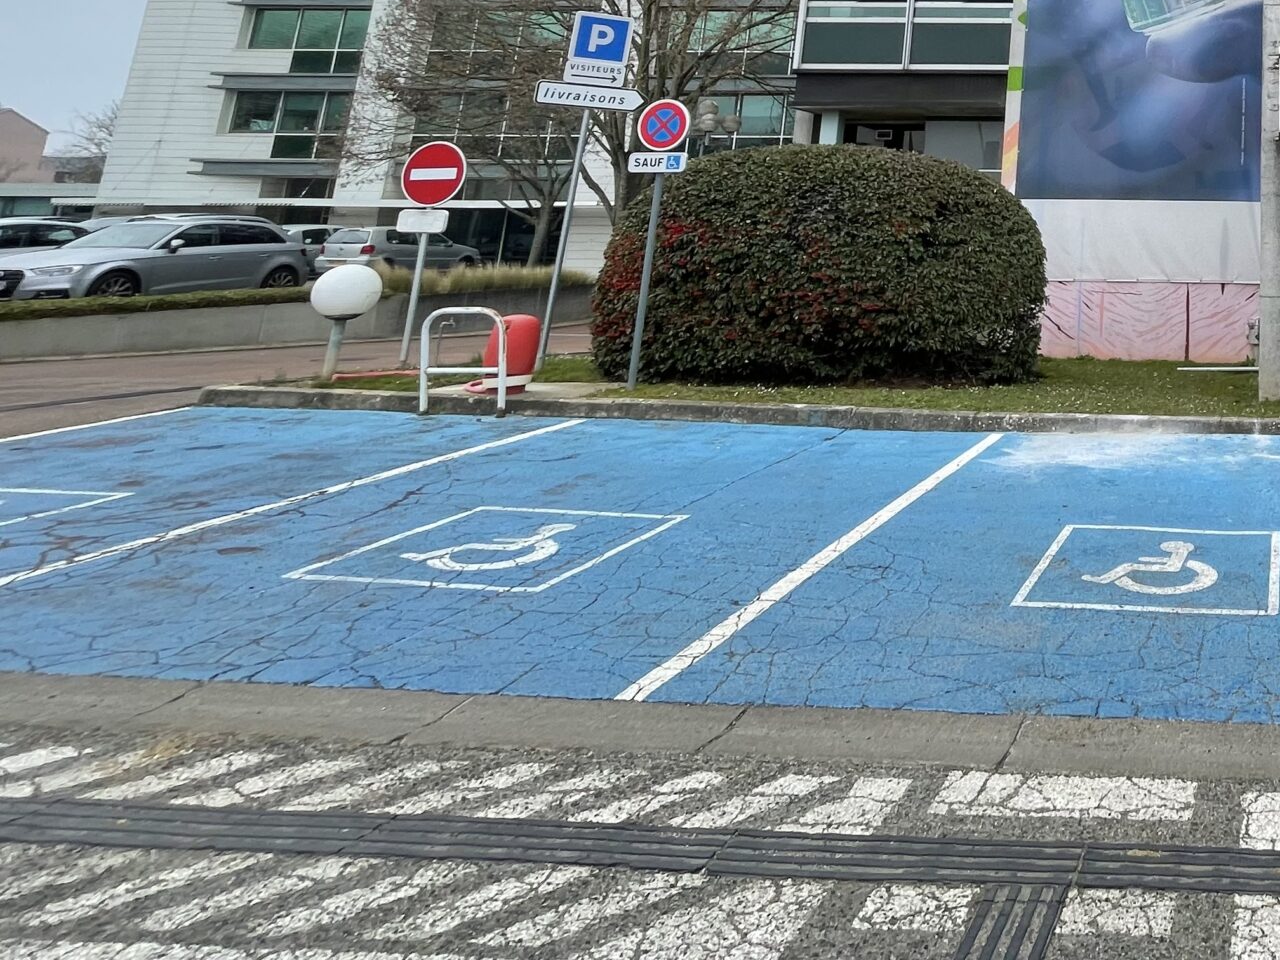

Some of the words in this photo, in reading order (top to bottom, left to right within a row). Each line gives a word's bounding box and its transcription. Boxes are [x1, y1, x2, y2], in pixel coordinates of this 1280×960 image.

[587, 23, 615, 53] P
[570, 63, 622, 75] VISITEURS
[543, 87, 626, 105] livraisons
[634, 157, 665, 168] SAUF
